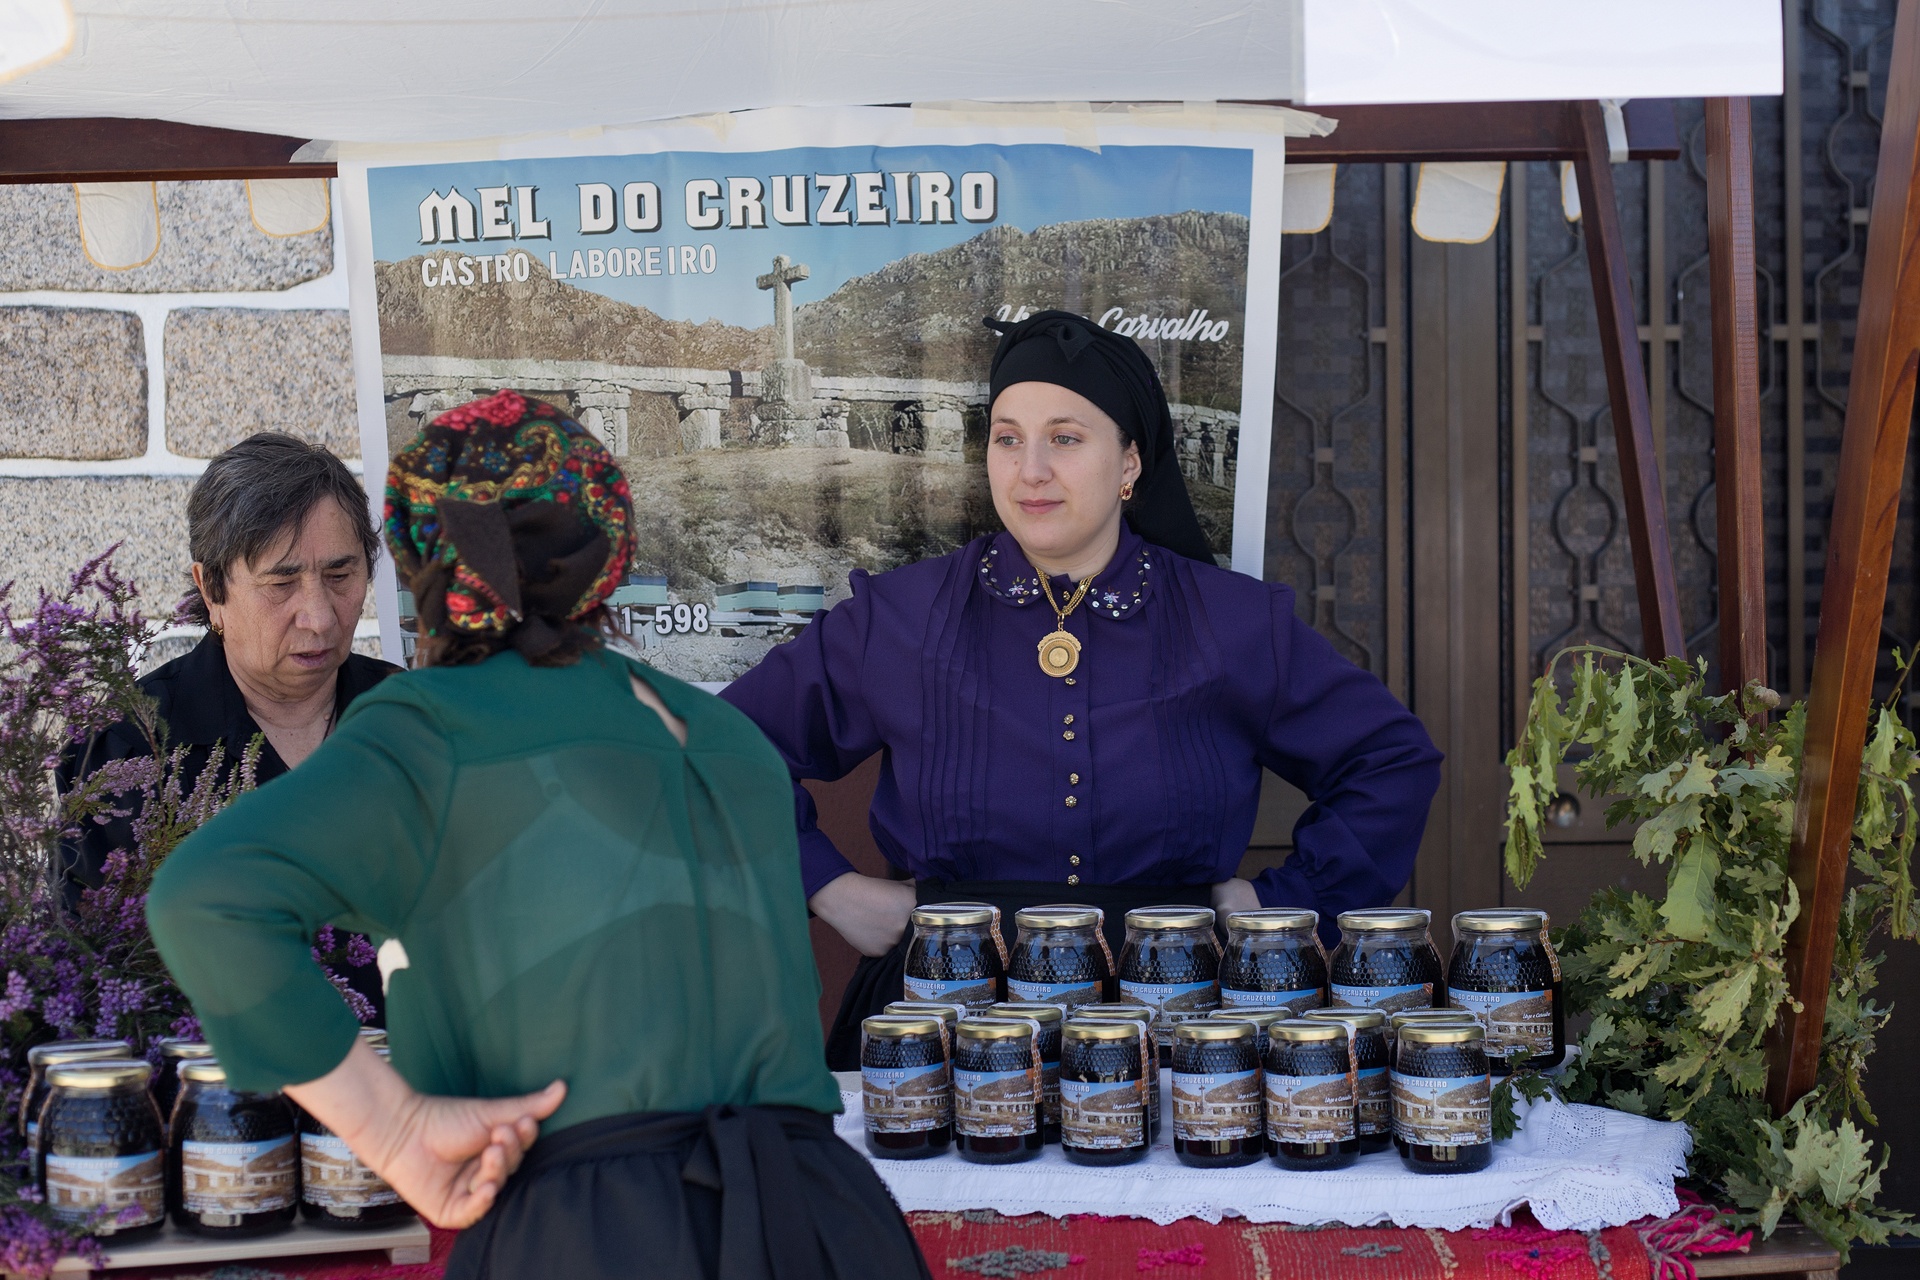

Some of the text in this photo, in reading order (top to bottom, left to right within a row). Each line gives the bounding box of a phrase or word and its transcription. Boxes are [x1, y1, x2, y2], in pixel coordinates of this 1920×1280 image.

[417, 170, 998, 245] MEL DO CRUZEIRO
[421, 244, 717, 287] CASTRO LABOREIRO
[1097, 306, 1230, 343] Carvalho
[655, 603, 710, 635] 598
[1021, 985, 1052, 993] CRUZEIRO
[1140, 986, 1173, 994] CRUZEIRO
[1347, 989, 1380, 997] CRUZEIRO
[1242, 994, 1277, 1002] CRUZEIRO
[1467, 994, 1501, 1003] CRUZEIRO
[1412, 1079, 1447, 1088] CRUZEIRO
